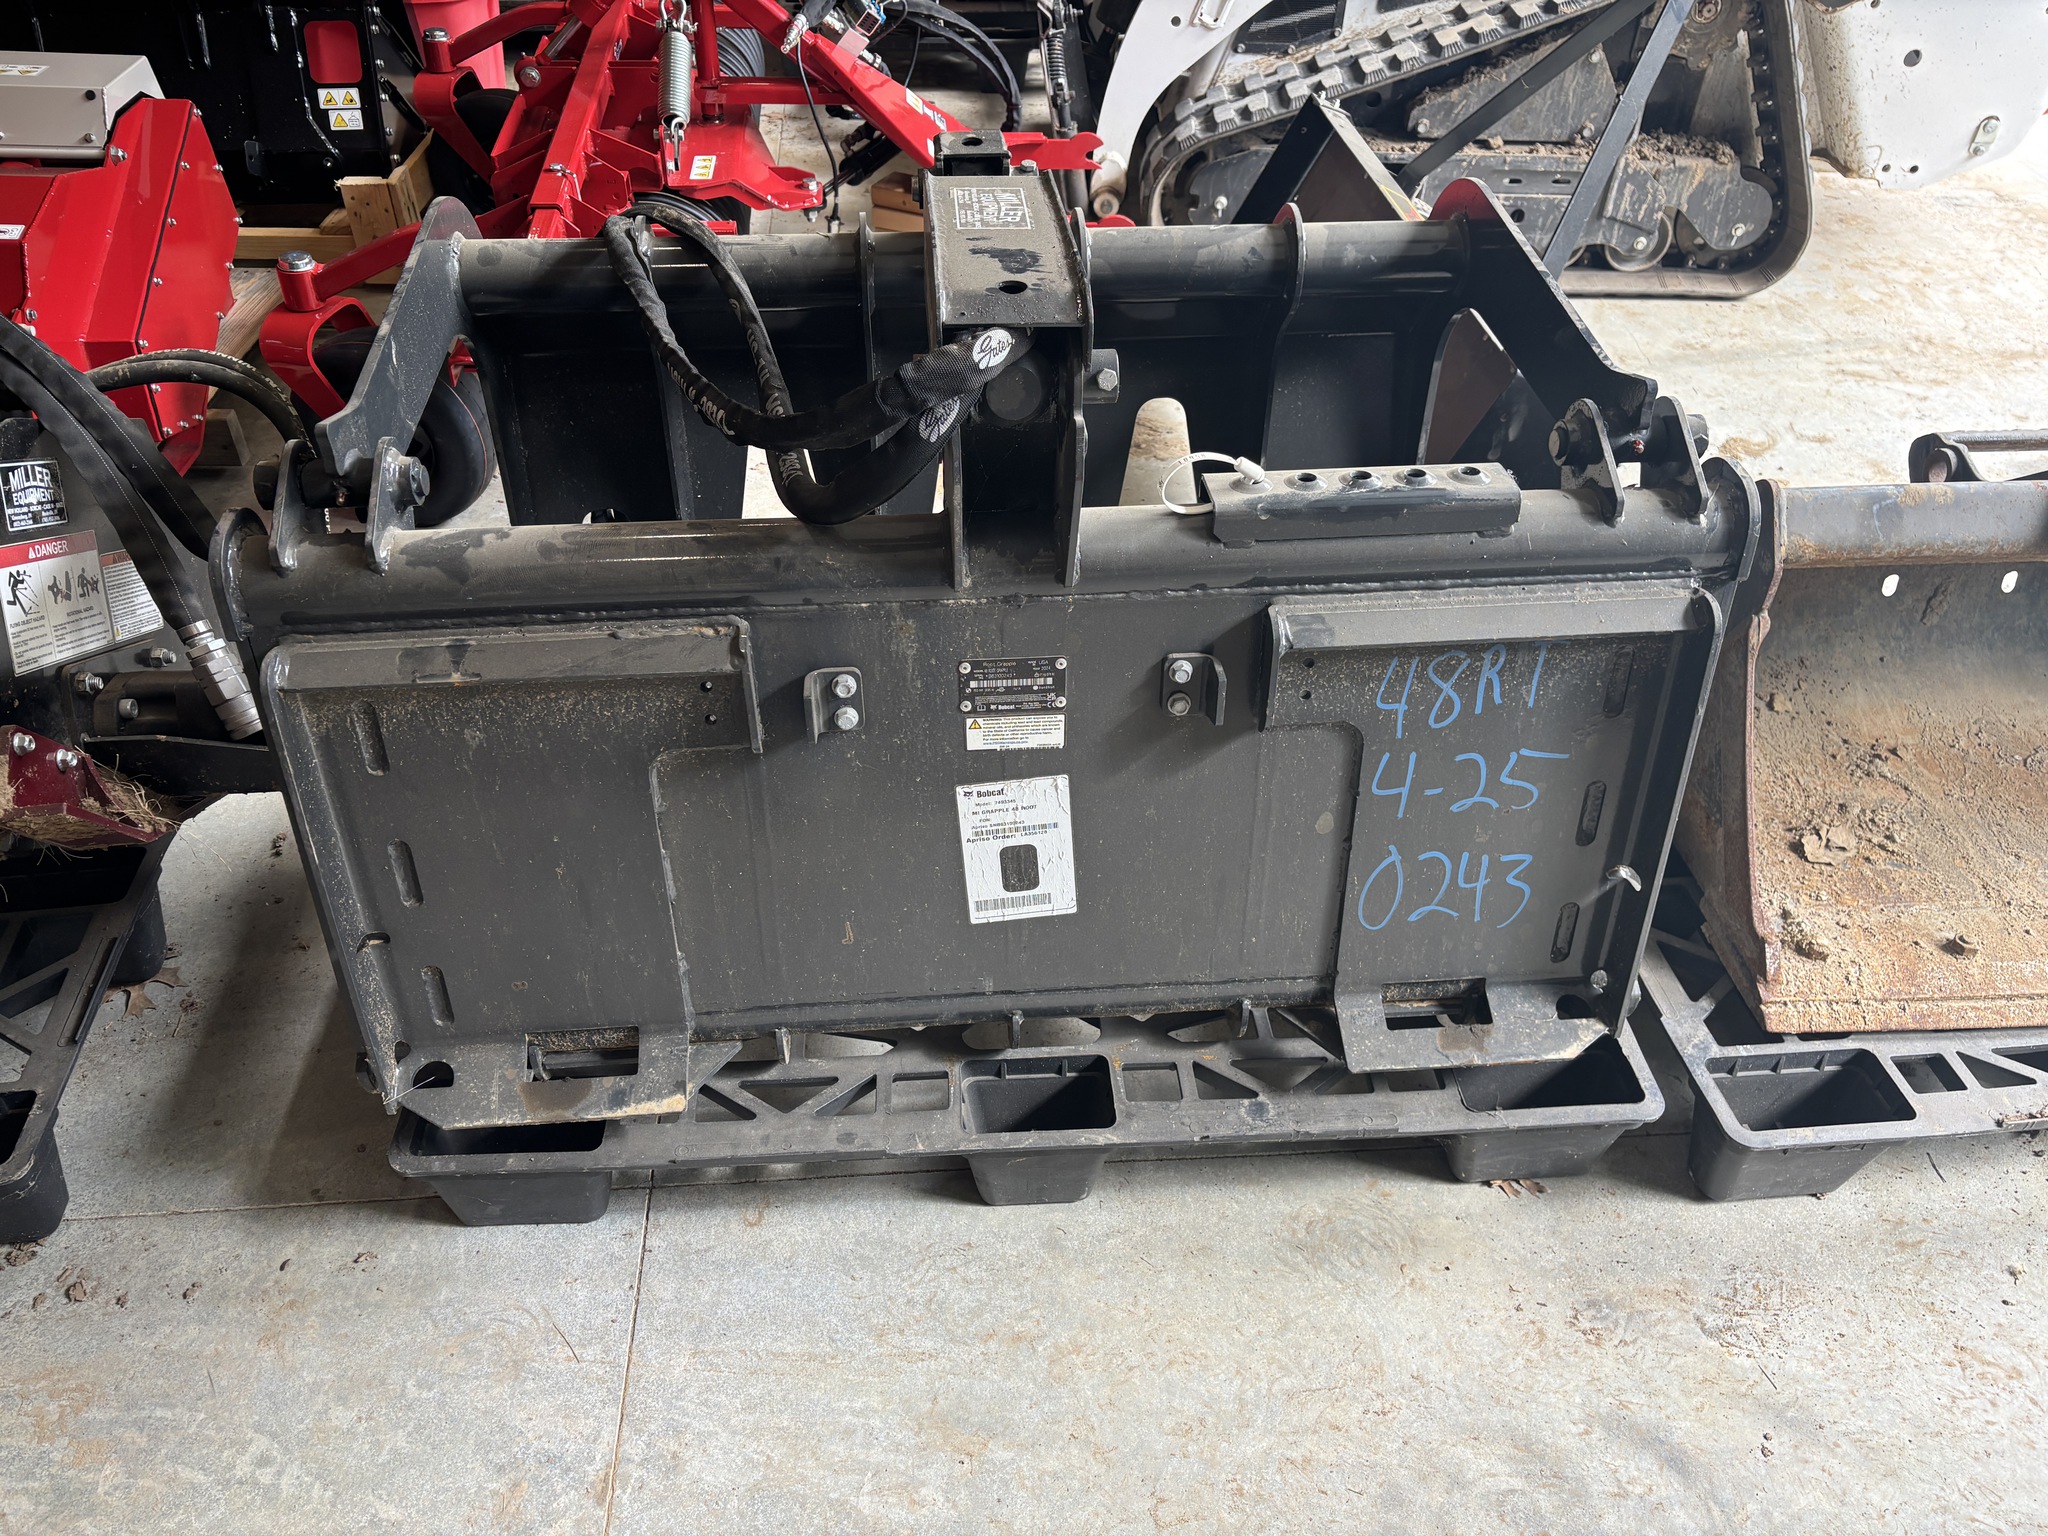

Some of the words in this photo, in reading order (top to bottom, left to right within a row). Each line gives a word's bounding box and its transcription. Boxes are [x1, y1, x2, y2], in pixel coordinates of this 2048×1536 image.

[995, 193, 1022, 222] MILLER
[977, 335, 1013, 367] Gates
[8, 464, 54, 492] MILLER
[12, 488, 55, 506] EQUIPMENT
[35, 540, 69, 558] DANGER
[976, 787, 1005, 798] Bobcat
[1371, 748, 1570, 819] 4-25
[981, 807, 1010, 815] GRAPPLE
[966, 836, 991, 844] Apriso
[992, 833, 1016, 841] Order:
[1358, 844, 1533, 930] 0243
